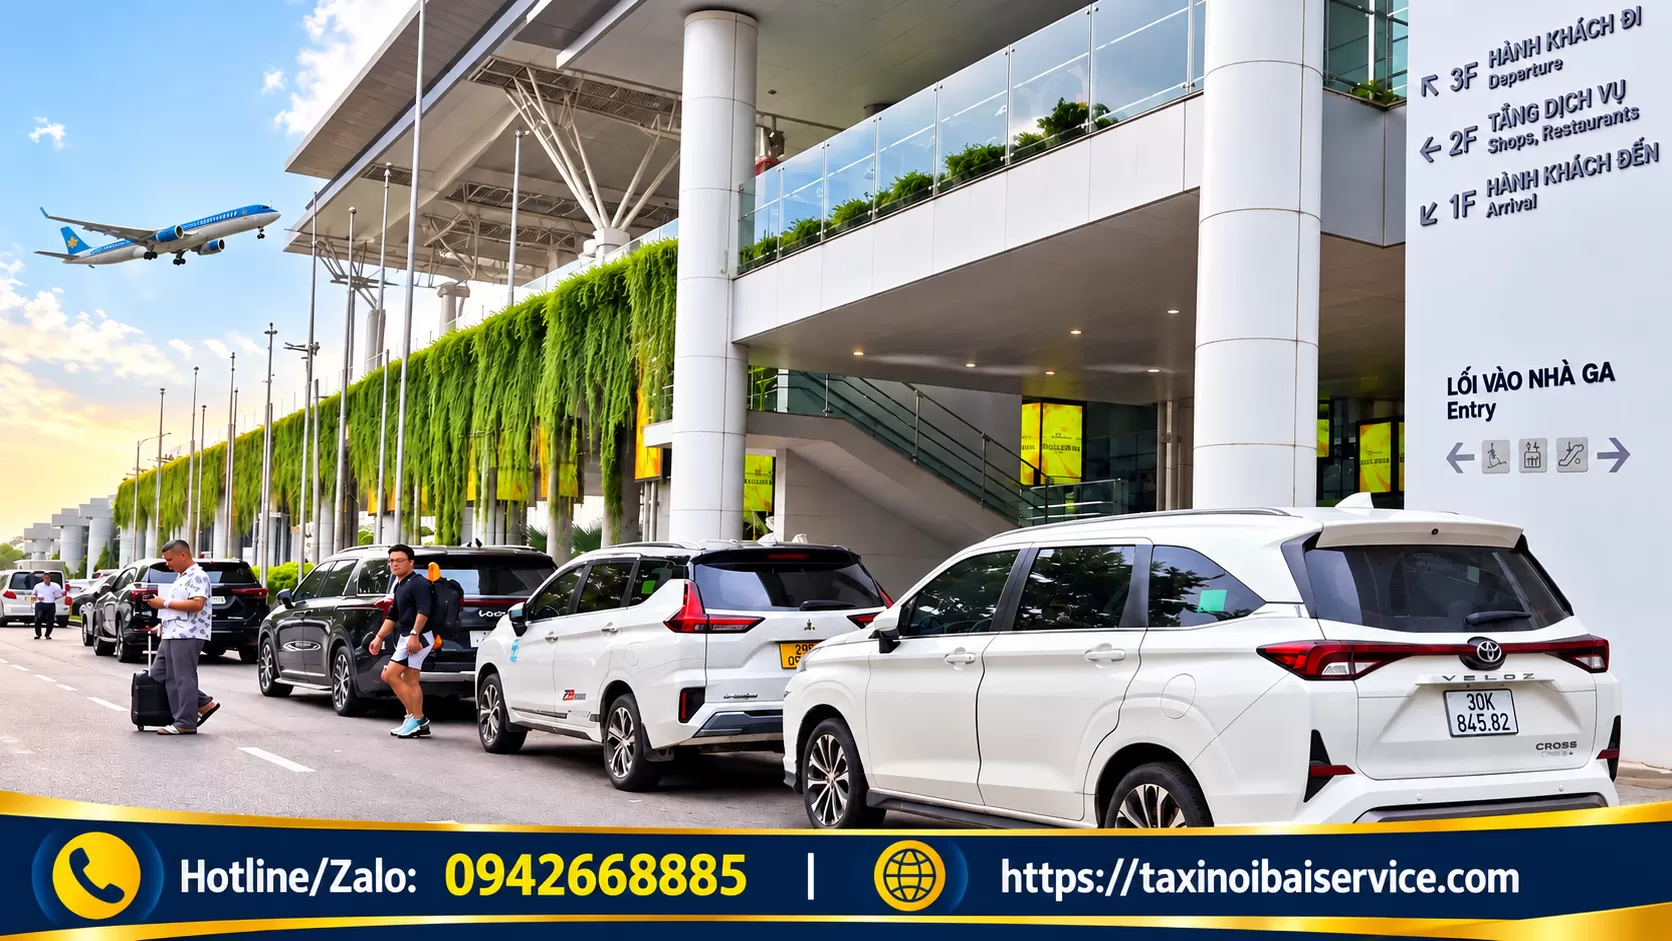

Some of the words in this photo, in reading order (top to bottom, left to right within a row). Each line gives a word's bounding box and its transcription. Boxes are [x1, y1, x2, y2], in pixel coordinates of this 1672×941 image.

[1450, 61, 1478, 92] 3F
[1488, 35, 1541, 68] HÀNH
[1546, 14, 1614, 52] KHÁCH
[1620, 5, 1642, 30] ĐI
[1488, 58, 1563, 90] Departure
[1449, 125, 1478, 157] 2F
[1488, 103, 1539, 132] TẦNG
[1544, 87, 1592, 119] DỊCH
[1597, 79, 1626, 105] VỤ
[1487, 133, 1539, 154] Shops,
[1542, 105, 1640, 142] Restaurants
[1449, 190, 1477, 219] 1F
[1486, 168, 1539, 198] HÀNH
[1543, 152, 1611, 186] KHÁCH
[1616, 136, 1660, 169] ĐẾN
[1486, 193, 1537, 219] Arrival
[1447, 365, 1477, 396] LỐI
[1482, 366, 1523, 393] VÀO
[1528, 358, 1576, 389] NHÀ
[1581, 361, 1616, 384] GA
[1447, 401, 1497, 422] Entry
[1442, 672, 1536, 682] VELOZ
[1466, 692, 1496, 711] 30K
[1457, 712, 1511, 733] 845.82
[1535, 740, 1578, 751] CROSS
